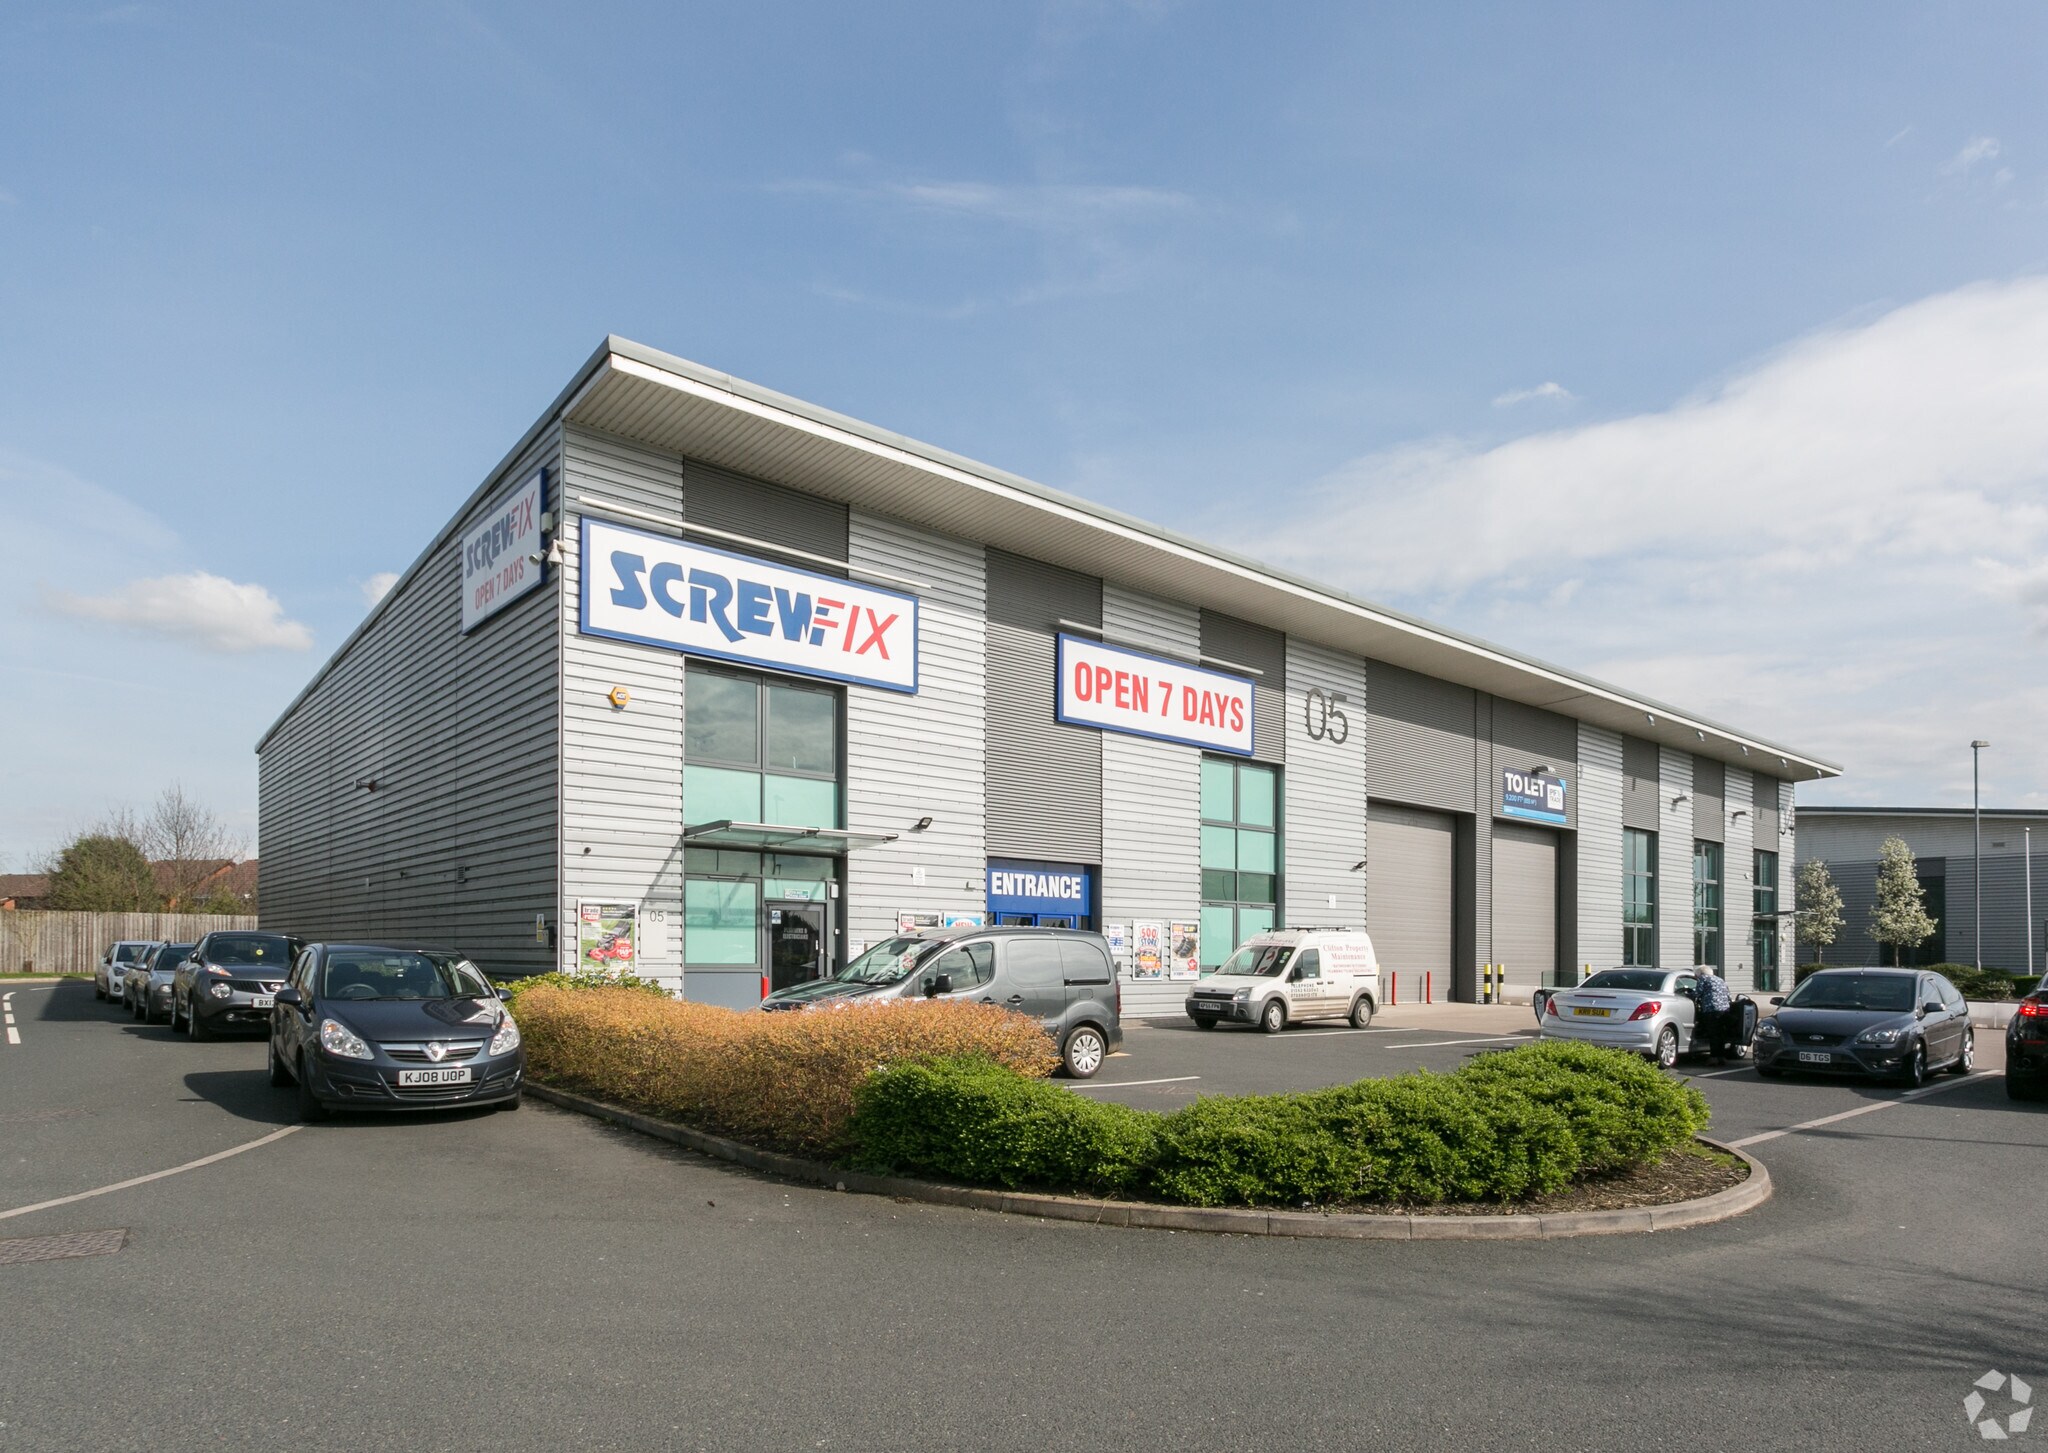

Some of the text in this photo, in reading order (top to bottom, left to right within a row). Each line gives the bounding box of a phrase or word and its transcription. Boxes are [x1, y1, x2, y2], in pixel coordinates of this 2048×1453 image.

[466, 490, 536, 579] SCREWFIX
[474, 555, 524, 610] OPEN 7 DAYS
[609, 550, 899, 661] SCREWFIX
[1074, 661, 1244, 733] OPEN 7 DAYS
[1306, 687, 1348, 745] 05
[1505, 772, 1523, 793] TO
[1524, 776, 1545, 797] LET
[991, 871, 1082, 899] ENTRANCE
[650, 910, 664, 922] 05
[1141, 927, 1157, 939] 500
[1800, 1053, 1830, 1062] D6 TGS
[405, 1070, 466, 1083] KJ08 UOP
